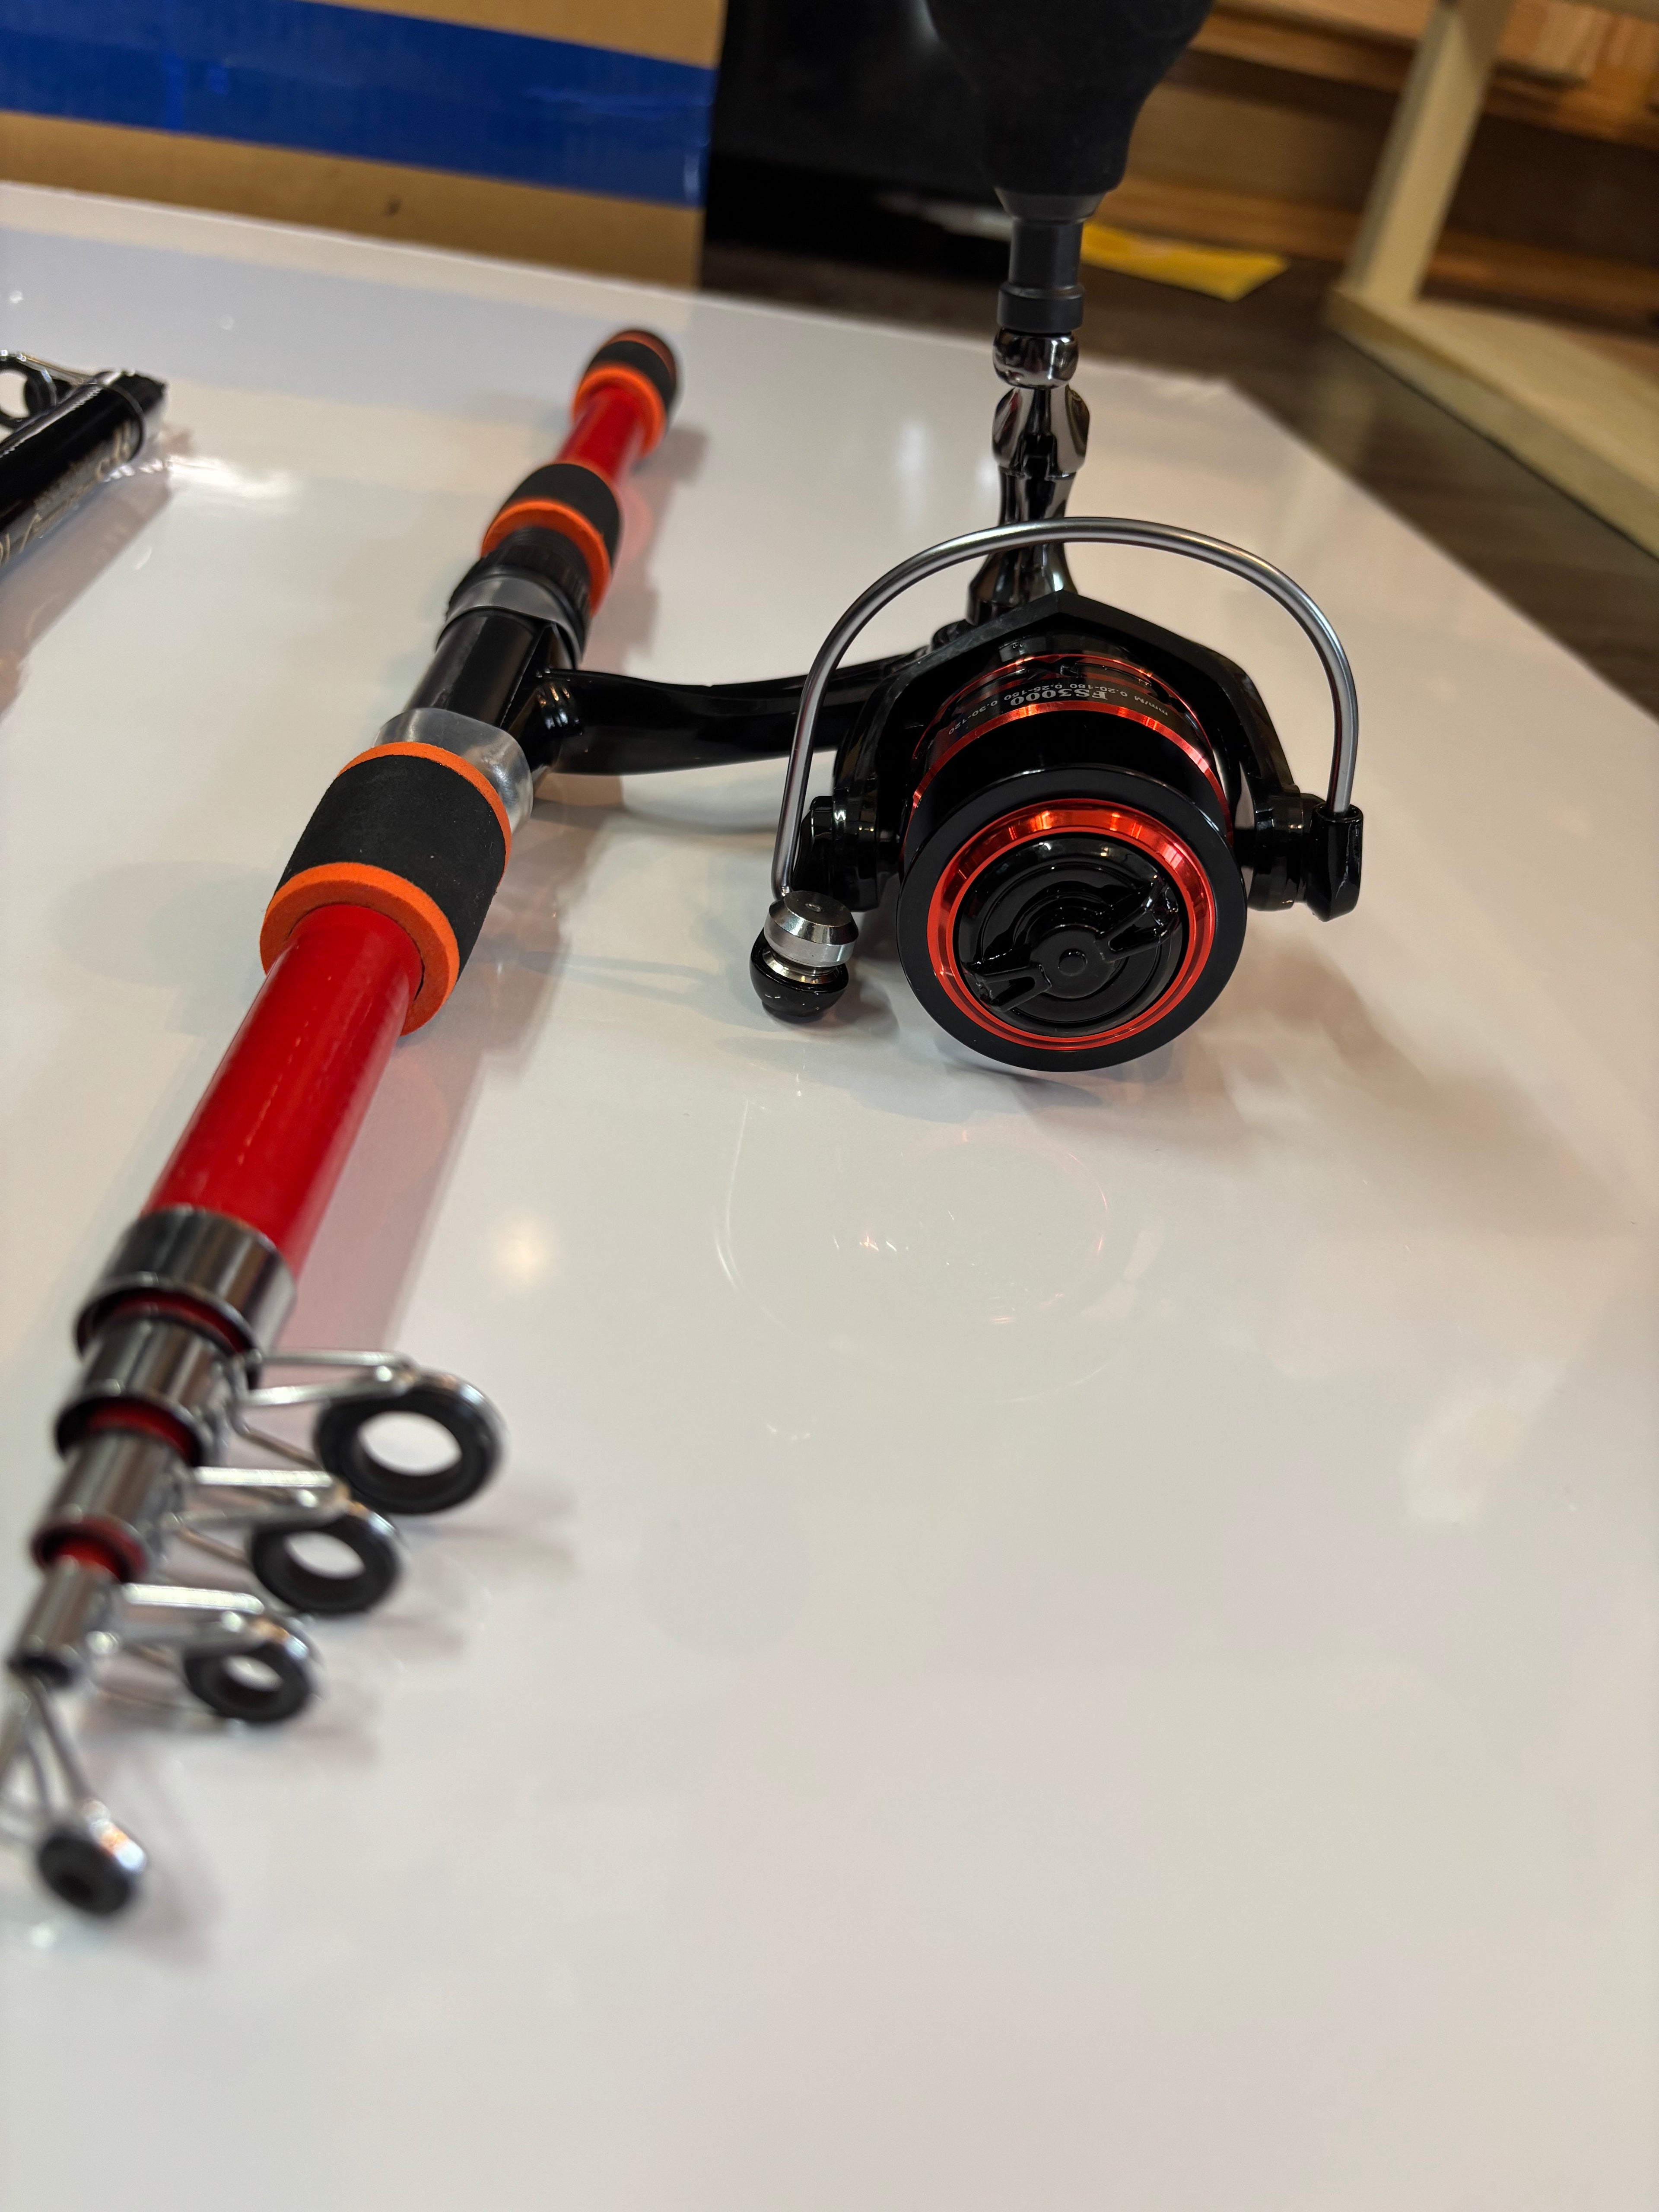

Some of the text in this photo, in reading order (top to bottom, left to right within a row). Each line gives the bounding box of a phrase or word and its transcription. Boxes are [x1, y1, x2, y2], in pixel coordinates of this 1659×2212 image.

[1004, 684, 1063, 701] 0.25-150
[1010, 688, 1108, 706] FS3000
[1070, 683, 1128, 697] 0.20-180
[948, 700, 998, 735] 0.30-120
